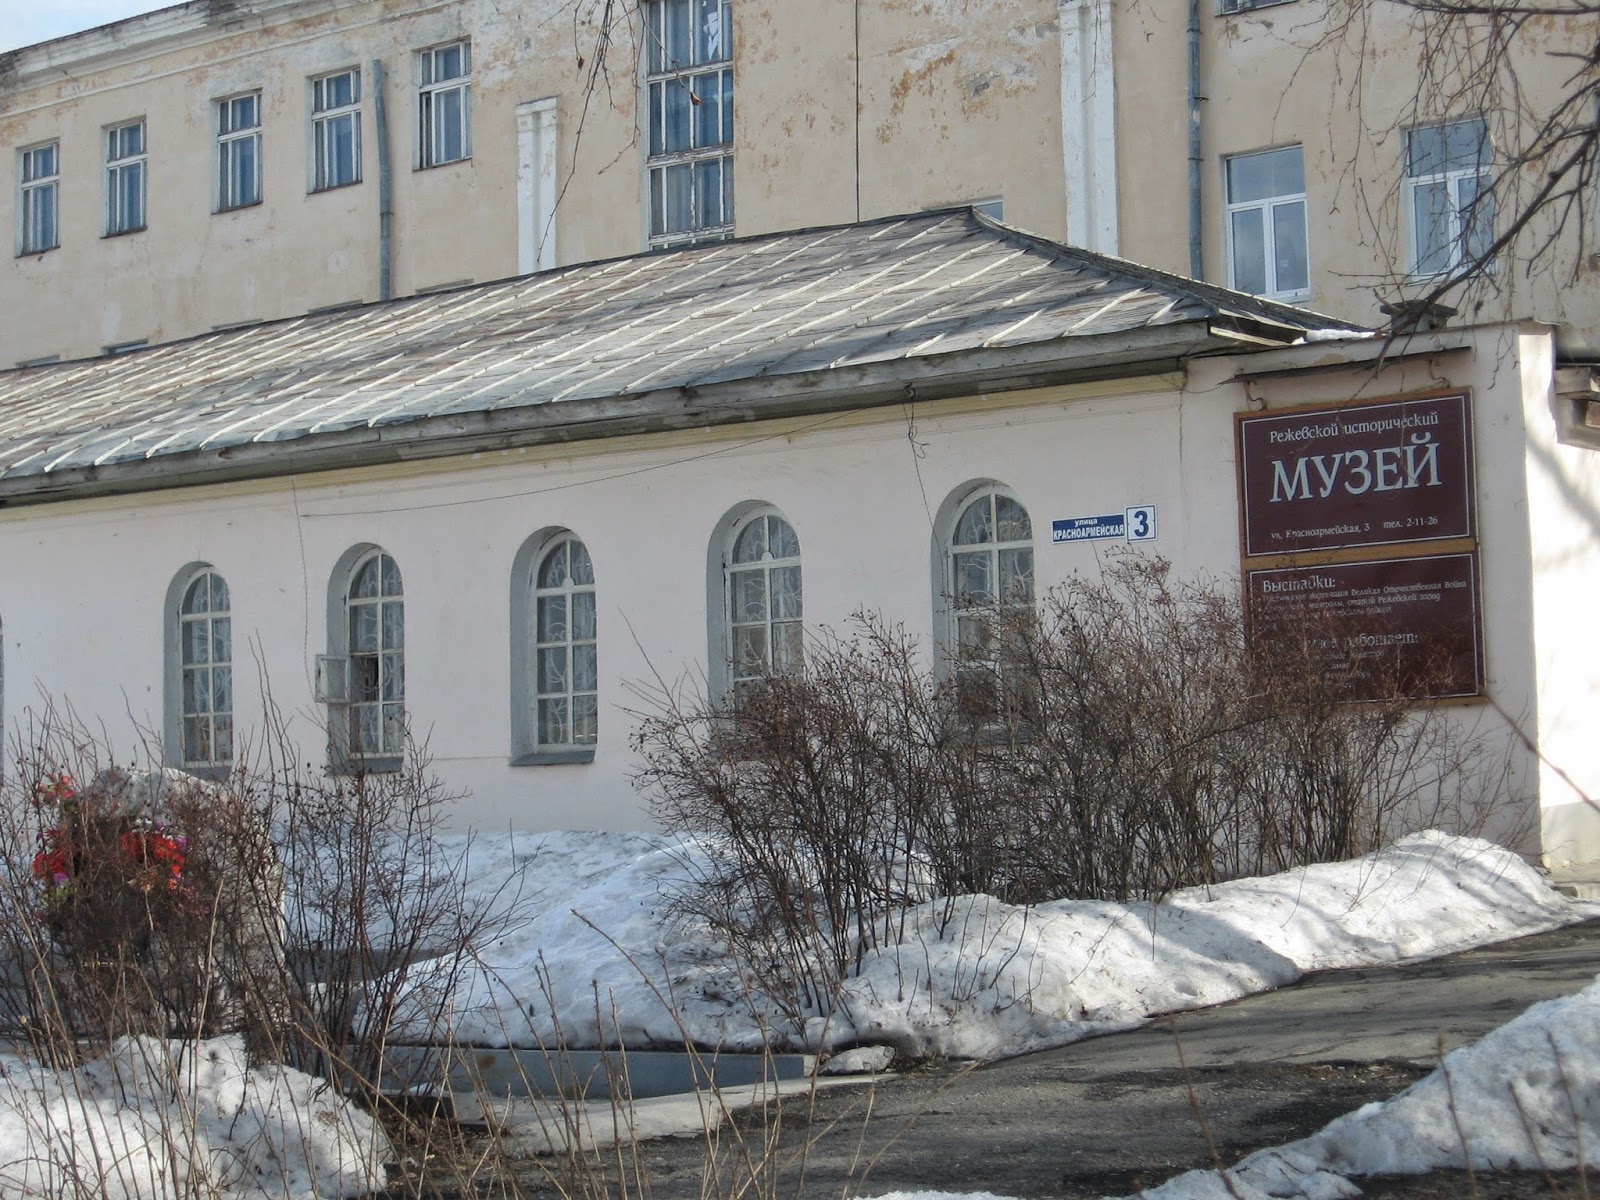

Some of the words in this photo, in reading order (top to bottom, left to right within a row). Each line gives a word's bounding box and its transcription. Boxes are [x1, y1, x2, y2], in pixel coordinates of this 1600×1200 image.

[1269, 422, 1339, 444] Режевской
[1344, 411, 1440, 435] исторический
[1269, 431, 1442, 503] МУЗЕЙ
[1053, 524, 1124, 540] КРАСНОАРМЕЙСКАЯ
[1074, 518, 1098, 528] улица
[1133, 510, 1150, 538] 3
[1364, 522, 1370, 532] 3
[1383, 520, 1403, 530] тел.
[1406, 515, 1439, 528] 2-11-26
